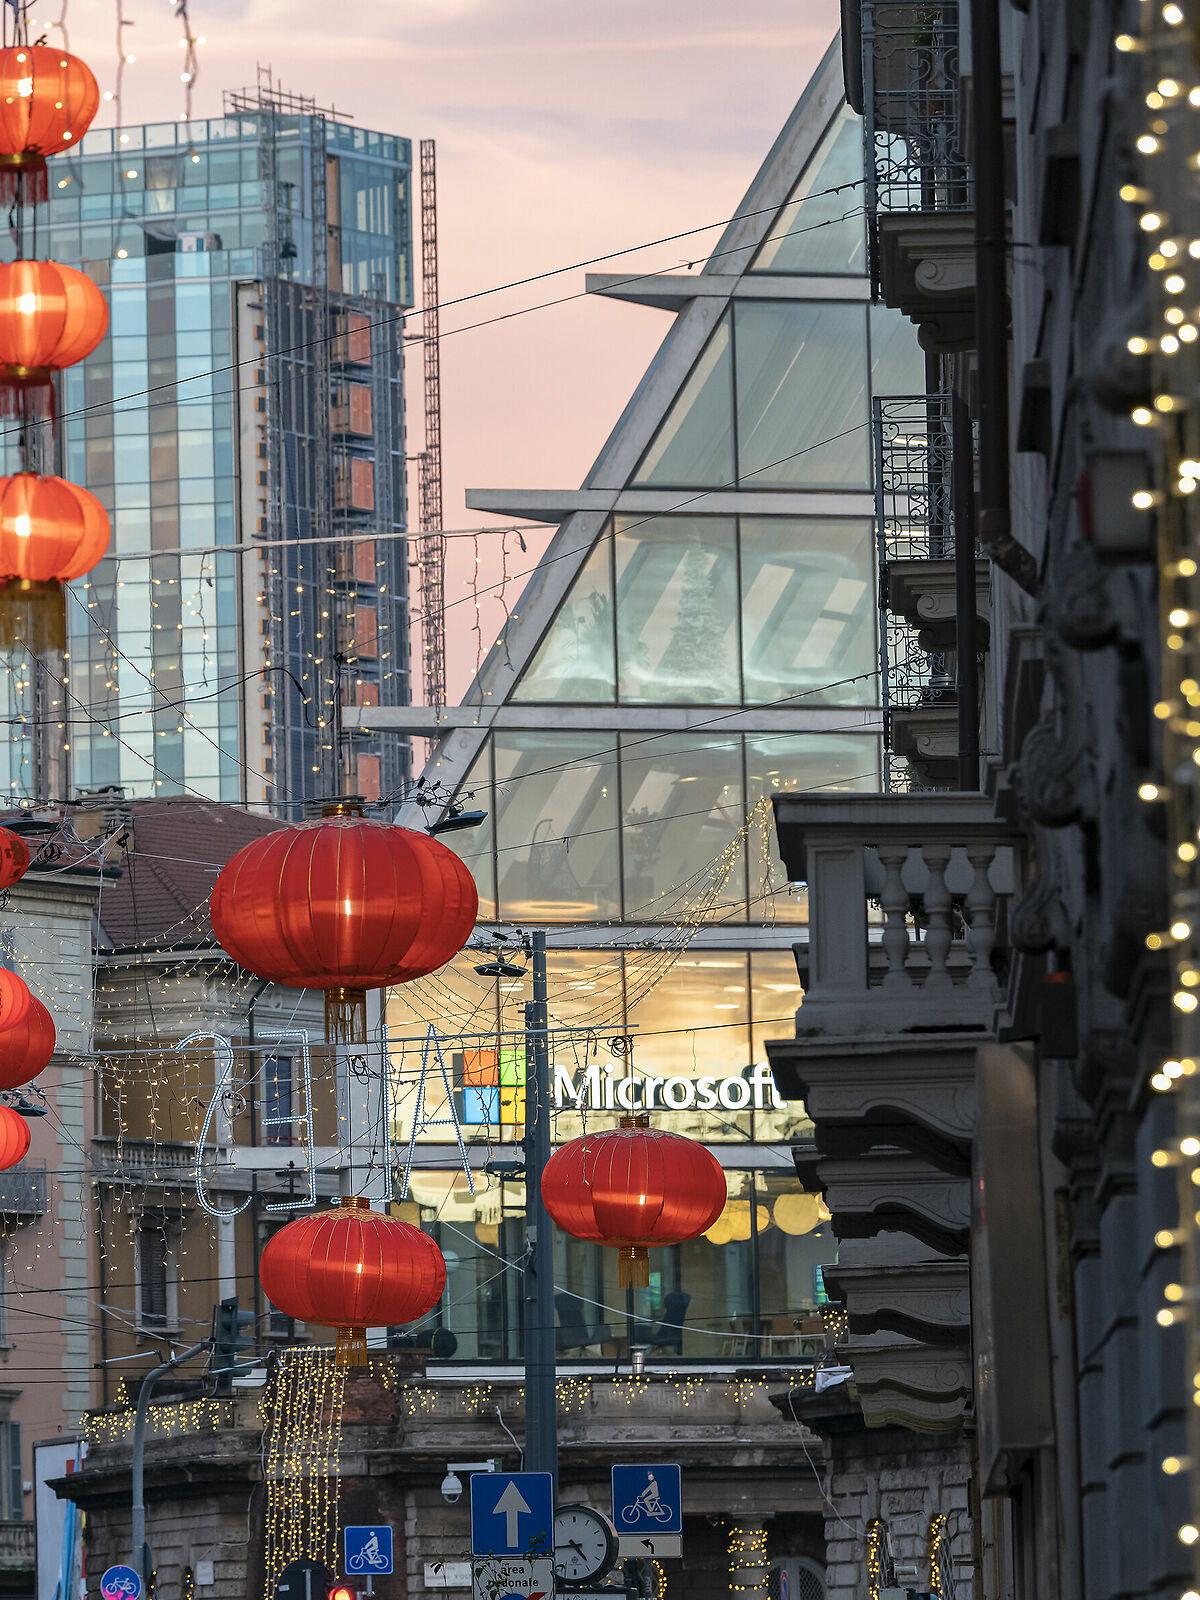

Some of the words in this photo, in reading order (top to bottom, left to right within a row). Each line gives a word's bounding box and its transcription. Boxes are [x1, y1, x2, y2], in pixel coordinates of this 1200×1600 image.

[553, 1061, 788, 1110] Microsoft
[501, 1566, 525, 1575] area
[488, 1578, 539, 1589] pdonale
